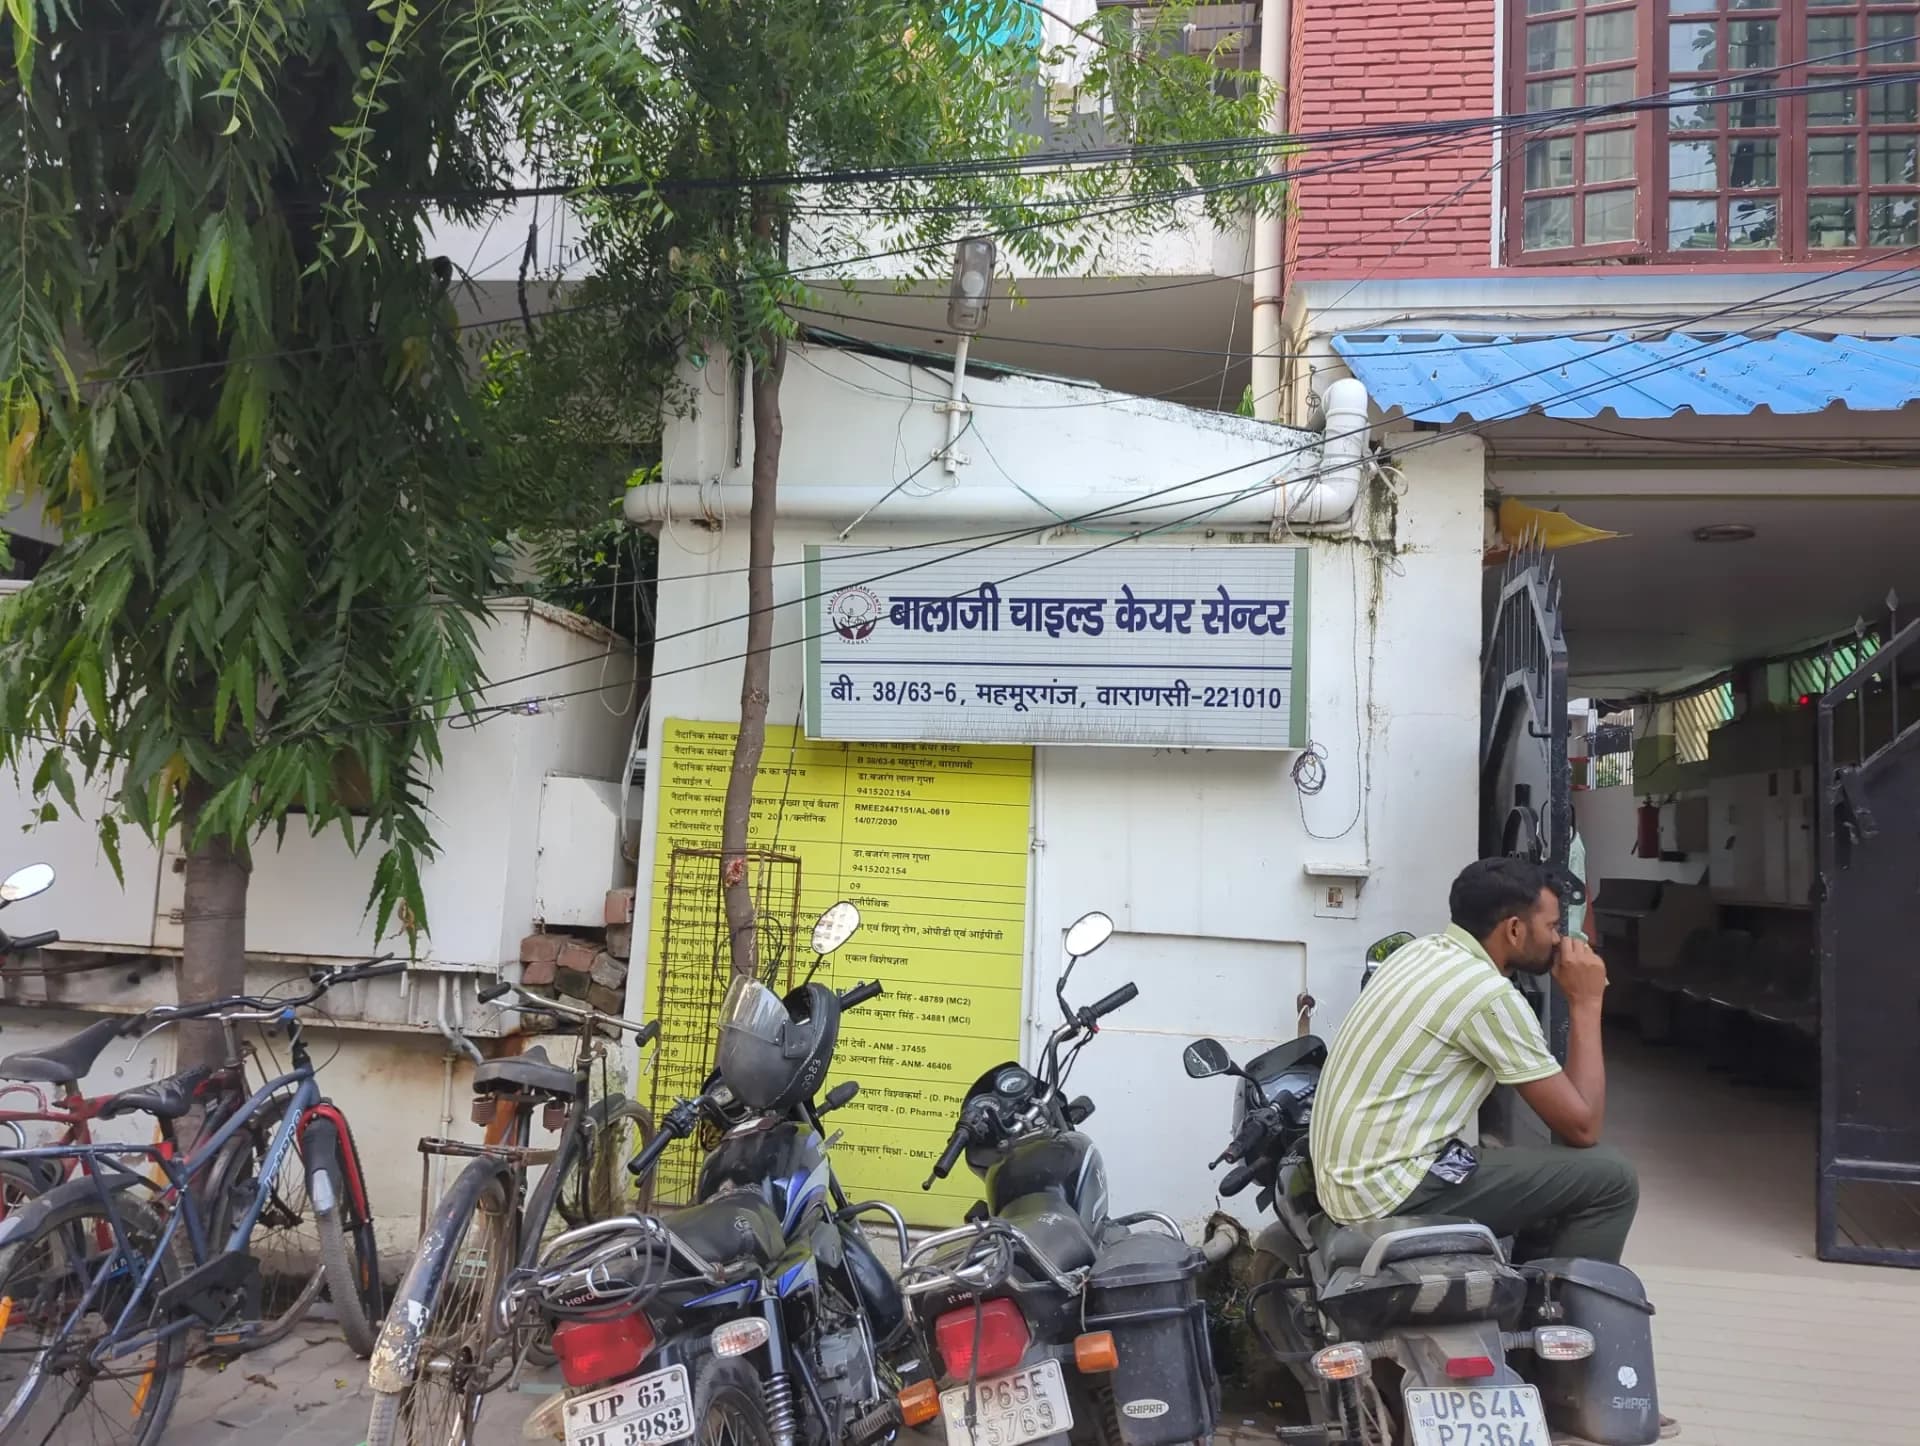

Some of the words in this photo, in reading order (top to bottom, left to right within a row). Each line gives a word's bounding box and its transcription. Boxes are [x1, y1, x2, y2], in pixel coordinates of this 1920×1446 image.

[889, 582, 1001, 632] बालाजी
[1009, 598, 1108, 638] चाइल्ड
[1114, 584, 1196, 634] केयर
[1201, 584, 1290, 636] सेन्टर
[829, 673, 861, 702] बी.
[872, 680, 967, 706] 38/63-6,
[975, 678, 1086, 712] महमूरगंज,
[1096, 679, 1282, 709] वाराणसी-221010
[856, 787, 911, 797] 9415202154
[854, 816, 898, 826] 14/07/2030
[852, 864, 907, 875] 9415202154
[850, 882, 861, 890] 09
[874, 1008, 897, 1020] कुमार
[873, 1042, 894, 1051] ANM
[910, 1107, 943, 1118] Pharma
[857, 1144, 880, 1155] कुमार
[564, 1291, 595, 1307] Hero
[588, 1394, 624, 1424] UP
[638, 1381, 666, 1409] 65
[1430, 1390, 1526, 1420] UP64A
[1126, 1403, 1164, 1415] SHIPRA
[623, 1407, 684, 1446] 3983
[1438, 1422, 1535, 1446] P7364
